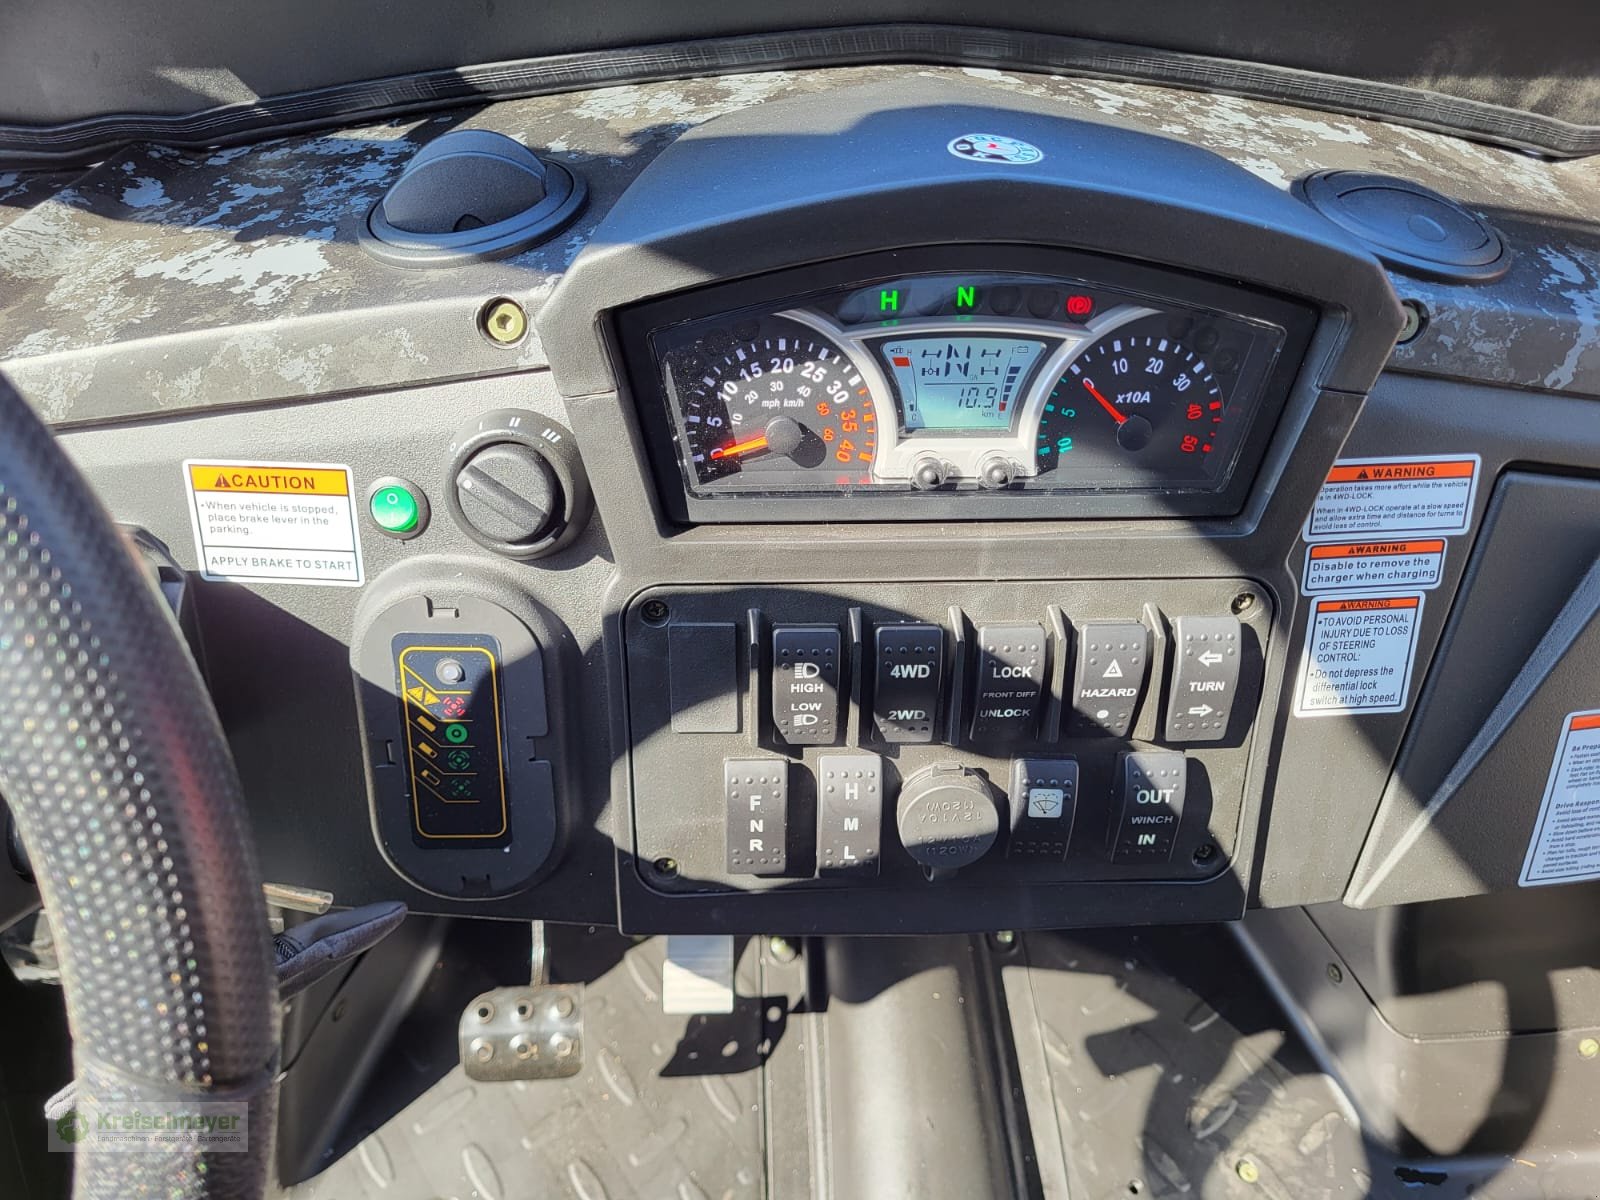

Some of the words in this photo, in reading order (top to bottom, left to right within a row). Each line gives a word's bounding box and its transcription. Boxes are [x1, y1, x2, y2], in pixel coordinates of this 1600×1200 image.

[880, 290, 898, 311] H
[957, 286, 974, 307] N
[740, 362, 763, 382] 15
[770, 358, 794, 374] 20
[800, 361, 827, 383] 25
[1112, 358, 1128, 375] 10
[1145, 357, 1164, 375] 20
[770, 380, 784, 392] 30
[1173, 373, 1191, 392] 30
[717, 381, 738, 402] 10
[745, 390, 759, 404] 20
[797, 384, 811, 397] 40
[827, 380, 849, 404] 30
[762, 399, 780, 409] mph
[783, 398, 804, 408] km/h
[958, 387, 998, 409] 10.9
[1115, 392, 1151, 404] x10A
[816, 403, 830, 416] 50
[1061, 407, 1076, 418] 5
[1187, 403, 1203, 420] 40
[707, 416, 723, 427] 5
[731, 413, 743, 425] 10
[841, 409, 858, 432] 35
[823, 428, 835, 441] 60
[1057, 437, 1073, 453] 10
[1181, 434, 1199, 452] 50
[836, 440, 854, 462] 40
[1373, 466, 1435, 479] WARNING
[231, 474, 316, 490] CAUTION
[1444, 480, 1468, 488] vehicle
[205, 501, 237, 511] When
[239, 502, 277, 512] vehicle
[280, 503, 289, 512] is
[291, 504, 339, 515] stopped,
[1345, 505, 1384, 513] 4WD-LOCK
[1385, 504, 1412, 512] operate
[1427, 502, 1442, 510] slow
[1443, 502, 1464, 510] speed
[208, 513, 237, 523] place
[239, 514, 269, 523] brake
[271, 514, 297, 524] lever
[301, 515, 310, 525] in
[312, 516, 329, 525] the
[1348, 513, 1365, 521] extra
[1396, 511, 1425, 519] distance
[1427, 510, 1436, 518] for
[1334, 521, 1347, 529] loss
[1355, 544, 1407, 554] WARNING
[211, 556, 249, 567] APPLY
[252, 557, 293, 568] BRAKE
[296, 559, 312, 569] TO
[315, 560, 353, 571] START
[1312, 561, 1354, 572] Disable
[1356, 561, 1367, 570] to
[1370, 559, 1410, 568] remove
[1413, 558, 1430, 566] the
[1311, 574, 1353, 584] charger
[1356, 571, 1385, 580] when
[1387, 569, 1436, 579] charging
[1346, 600, 1391, 609] WARNING
[1323, 617, 1335, 627] TO
[1335, 616, 1362, 626] AVOID
[1363, 614, 1409, 625] PERSONAL
[1321, 629, 1352, 639] INJURY
[1353, 627, 1372, 637] DUE
[1373, 627, 1385, 636] TO
[1386, 625, 1409, 635] LOSS
[1319, 641, 1332, 651] OF
[1332, 639, 1376, 650] STEERING
[1317, 652, 1361, 663] CONTROL:
[890, 664, 930, 678] 4WD
[993, 666, 1032, 679] LOCK
[1315, 669, 1327, 679] Do
[1328, 669, 1343, 679] not
[1344, 667, 1378, 679] depress
[1380, 666, 1394, 676] the
[790, 683, 824, 693] HIGH
[1080, 687, 1137, 698] HAZARD
[1188, 681, 1225, 692] TURN
[1312, 680, 1358, 692] differential
[1360, 680, 1378, 690] lock
[1310, 695, 1338, 706] switch
[1339, 695, 1347, 703] at
[1349, 694, 1367, 706] high
[1369, 692, 1397, 704] speed.
[791, 702, 822, 711] LOW
[979, 708, 1031, 718] UNLOCK
[887, 710, 926, 720] 2WD
[845, 783, 858, 800] H
[1136, 789, 1175, 804] OUT
[750, 795, 762, 811] F
[750, 820, 763, 832] N
[843, 817, 859, 831] M
[1131, 815, 1173, 825] WINCH
[750, 839, 763, 852] R
[1137, 834, 1156, 845] IN
[844, 846, 855, 860] L
